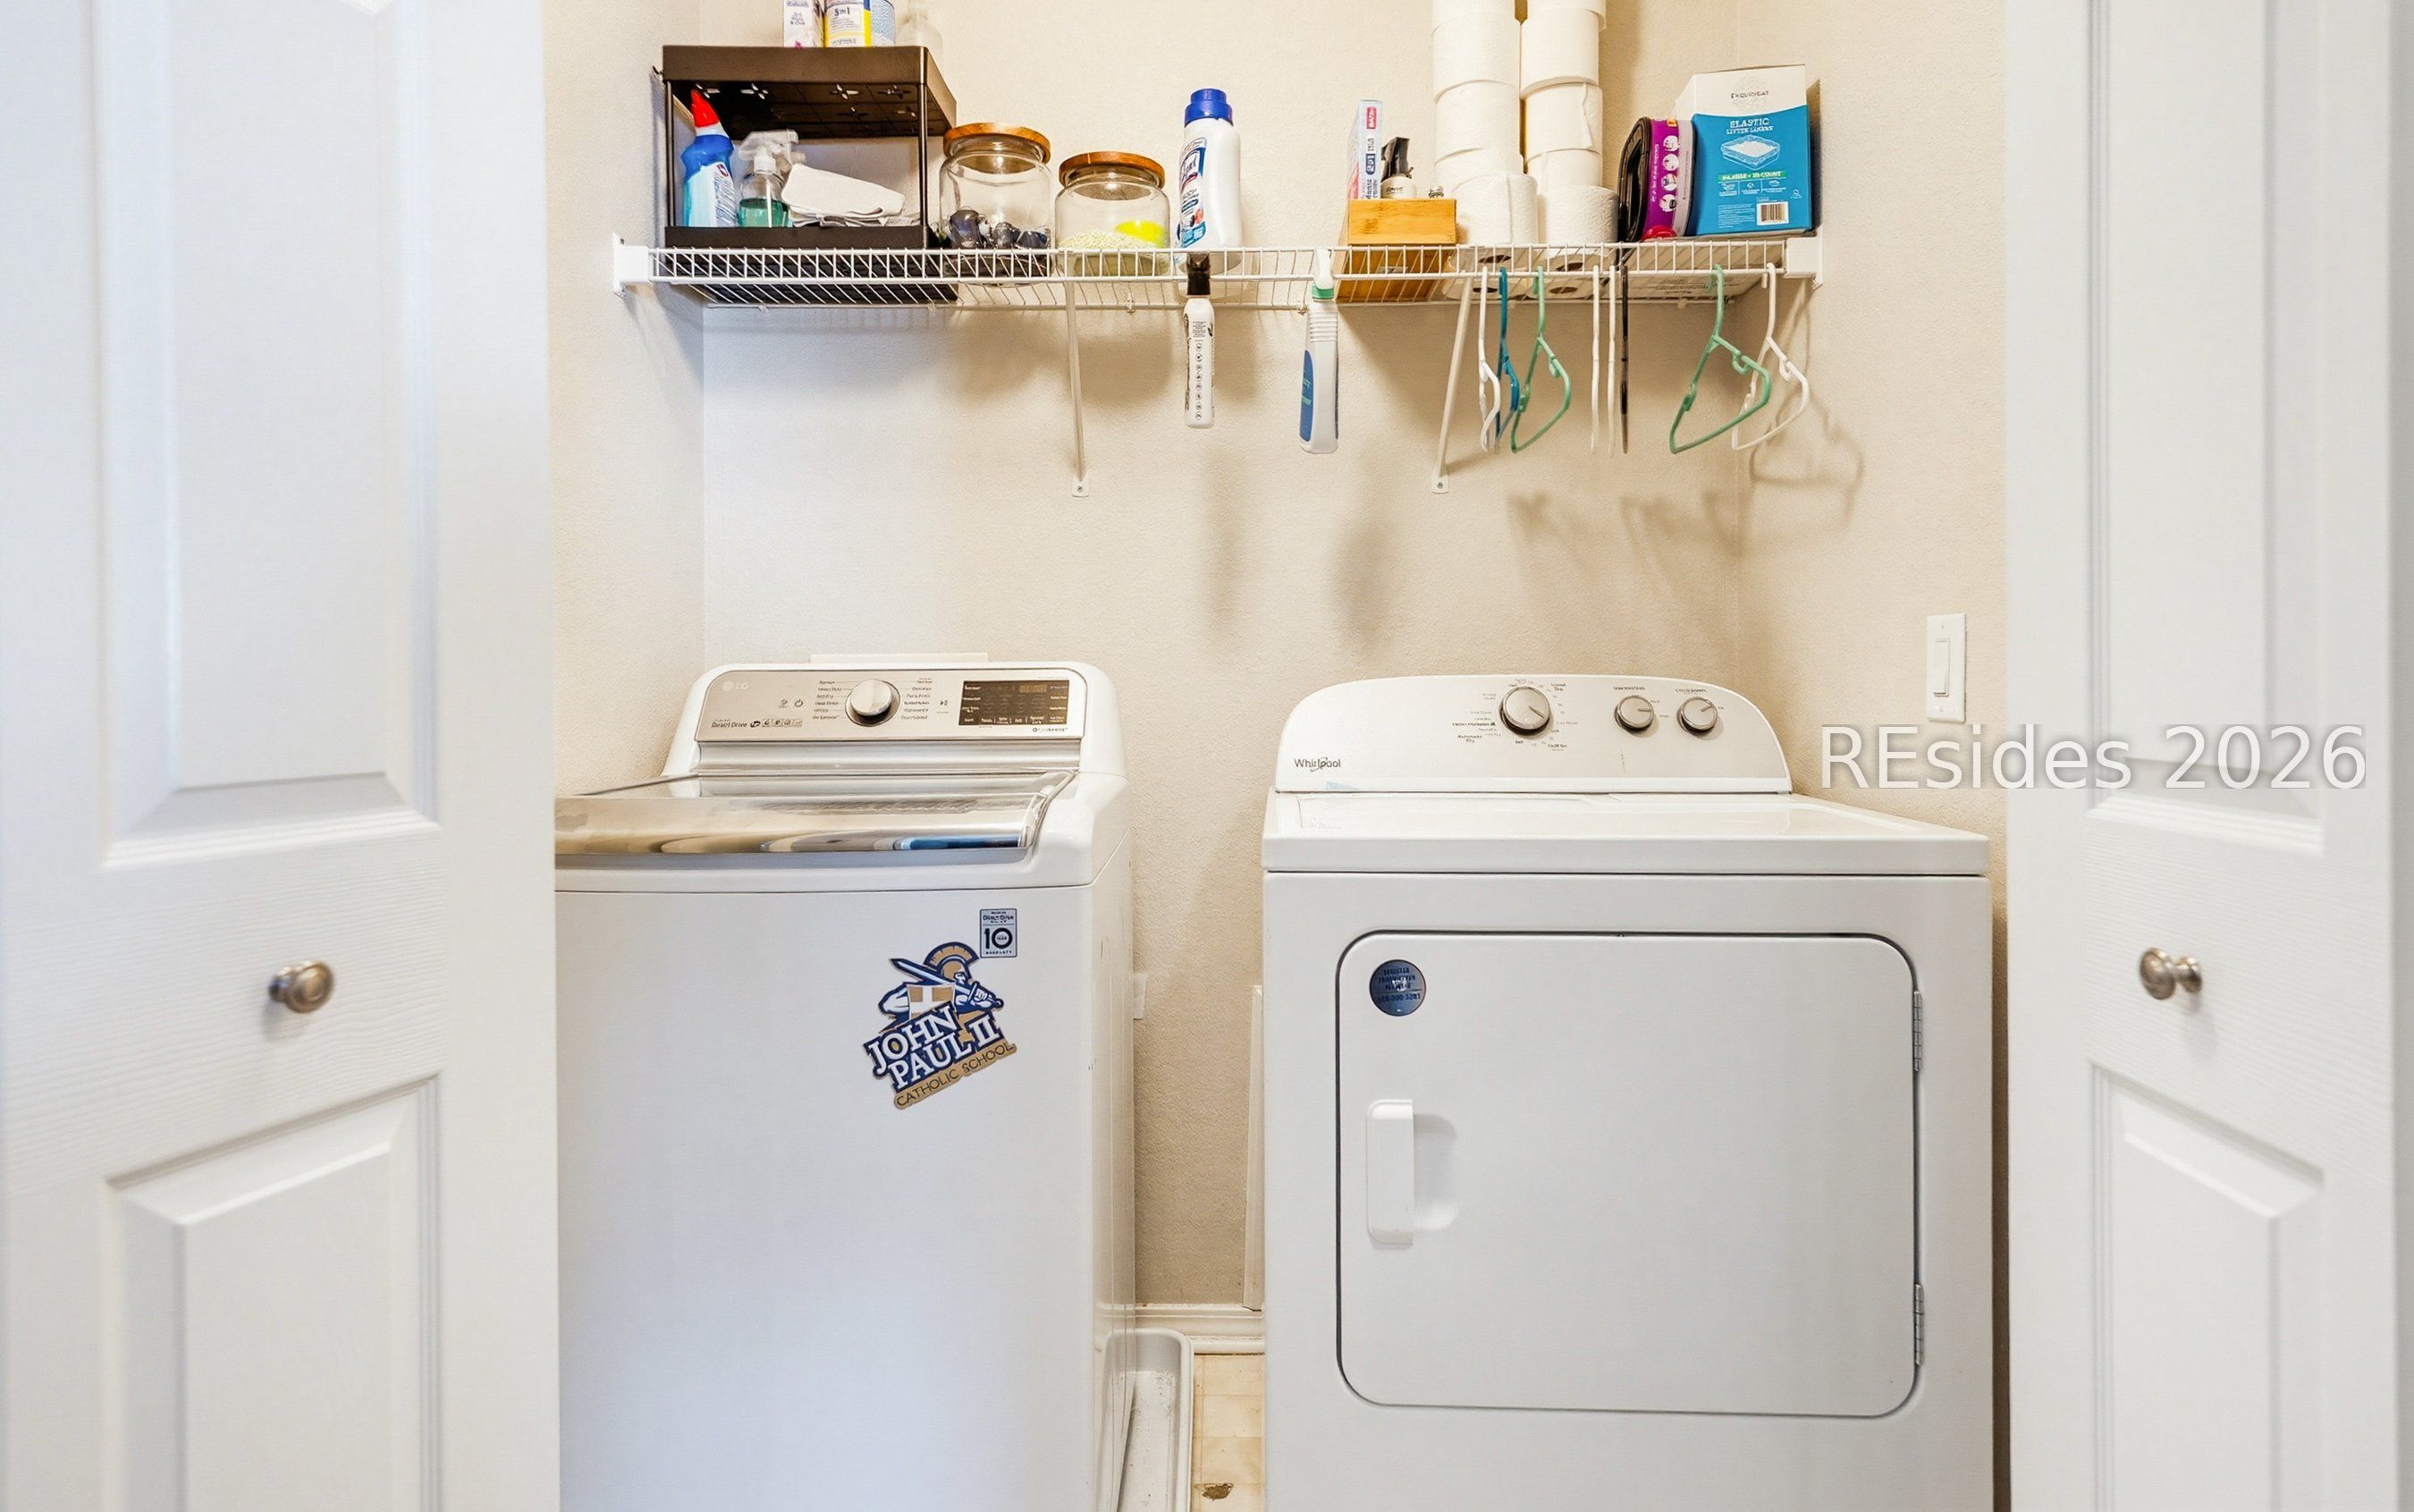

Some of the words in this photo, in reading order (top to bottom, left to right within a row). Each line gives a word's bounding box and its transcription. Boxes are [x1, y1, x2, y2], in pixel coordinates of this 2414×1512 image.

[1730, 117, 1769, 128] ELASTIC
[1294, 757, 1341, 772] Whirlpool
[984, 927, 1013, 950] 10
[868, 1005, 959, 1074] JOHN
[888, 1032, 973, 1090] PAUL
[969, 1015, 1000, 1047] II
[897, 1069, 959, 1106] CATHOLIC
[962, 1042, 1015, 1073] SCHOOL
